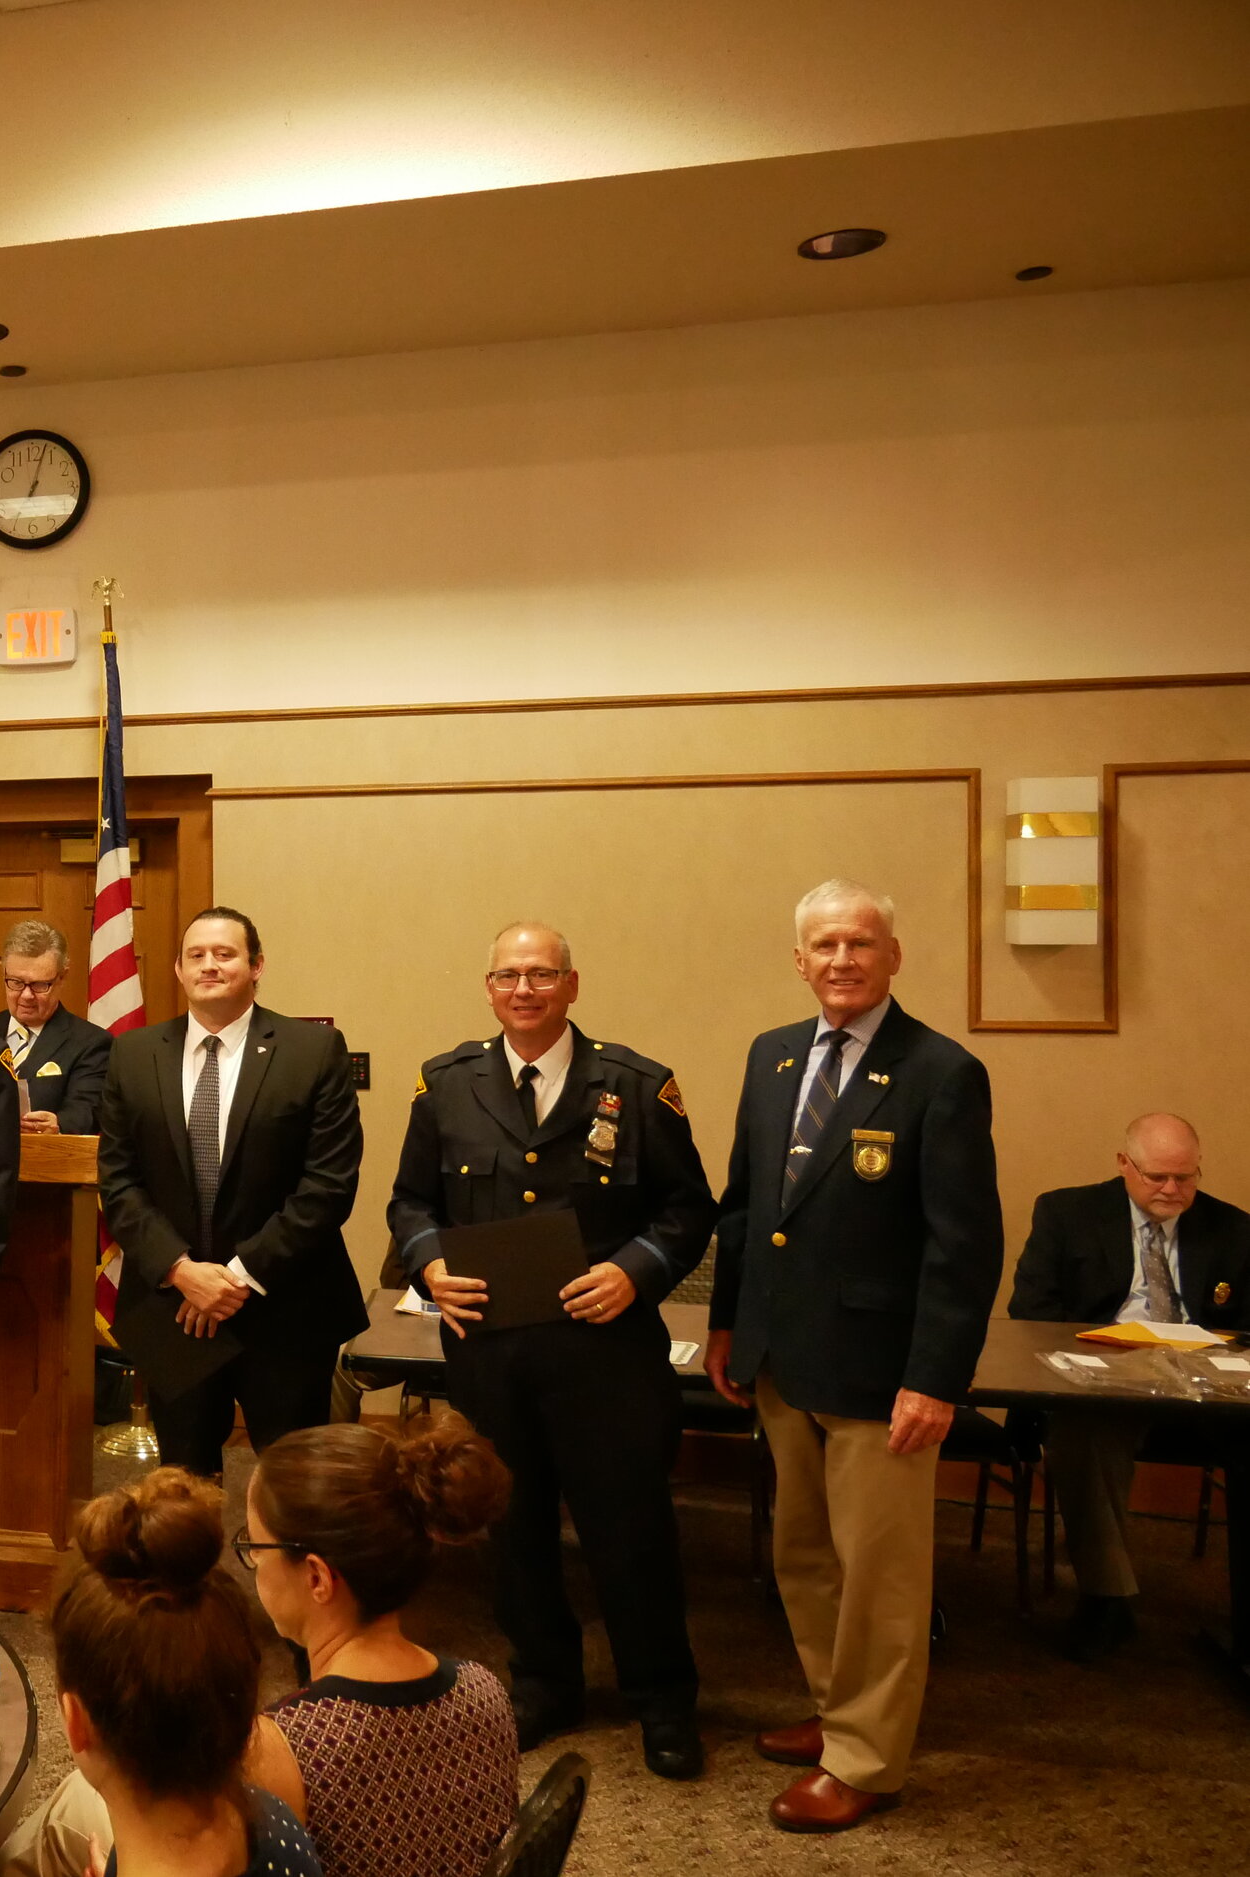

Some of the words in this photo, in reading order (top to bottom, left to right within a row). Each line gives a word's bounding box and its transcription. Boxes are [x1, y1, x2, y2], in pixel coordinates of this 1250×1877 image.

[11, 452, 22, 468] 11
[27, 446, 40, 462] 12
[48, 450, 54, 465] 1
[60, 461, 69, 477] 2
[67, 480, 76, 495] 3
[28, 519, 37, 534] 6
[47, 515, 56, 529] 5
[6, 611, 64, 660] EXIT
